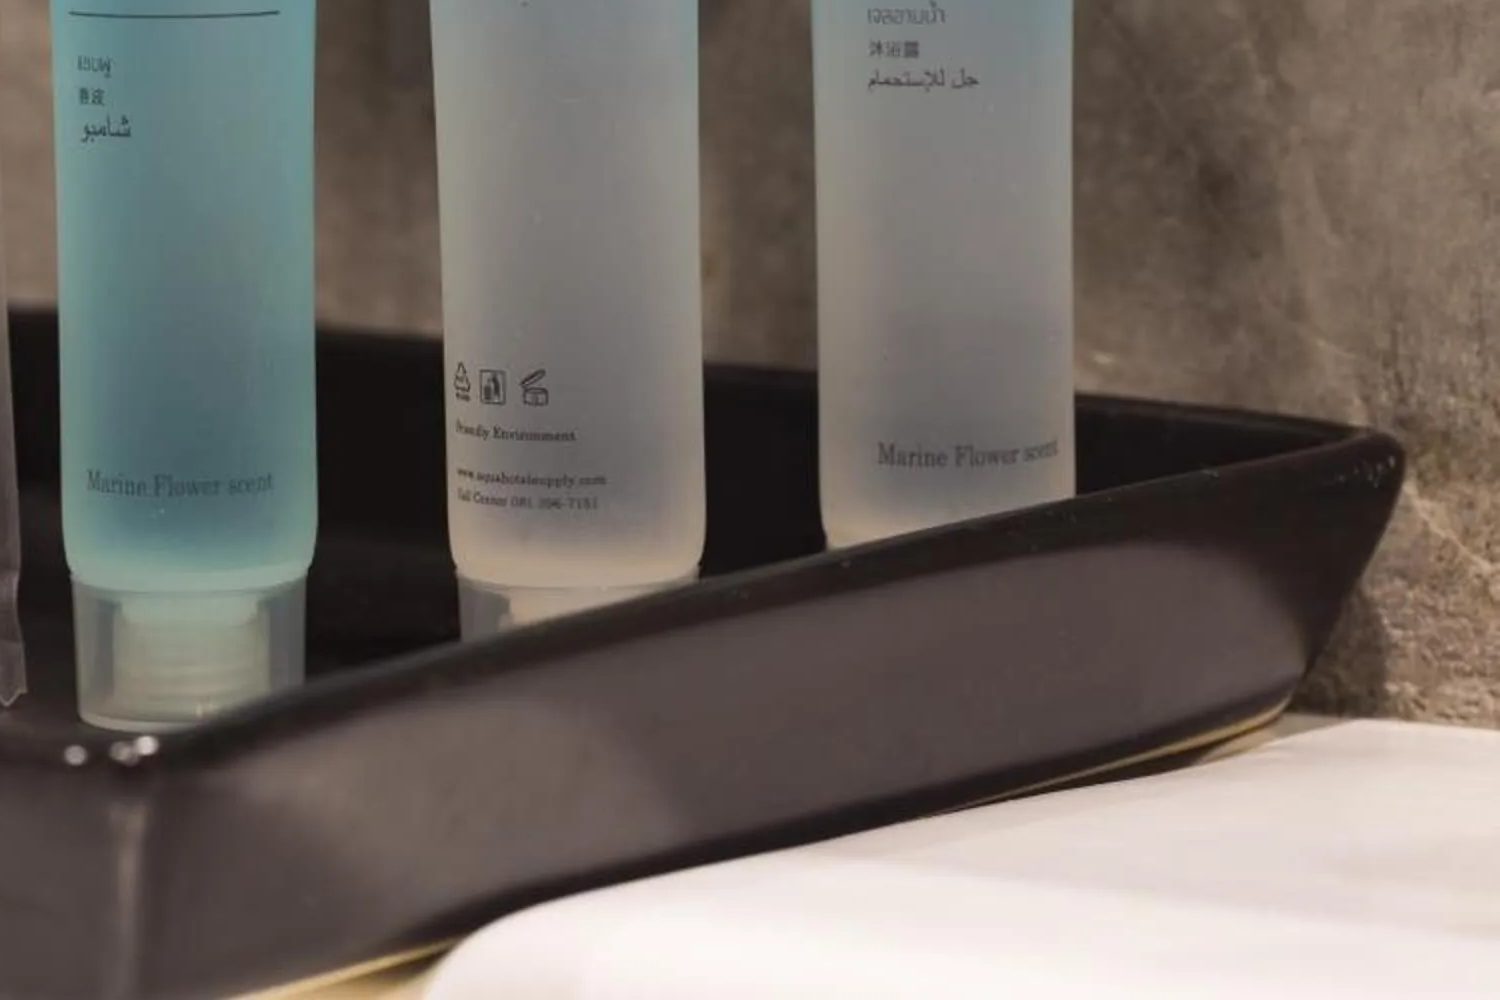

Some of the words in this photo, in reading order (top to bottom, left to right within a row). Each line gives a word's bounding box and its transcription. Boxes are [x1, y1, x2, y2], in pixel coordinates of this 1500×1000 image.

[876, 441, 949, 469] Marine
[954, 444, 1020, 469] Flower
[85, 468, 148, 498] Marine
[153, 472, 222, 498] Flower
[227, 471, 274, 497] scent
